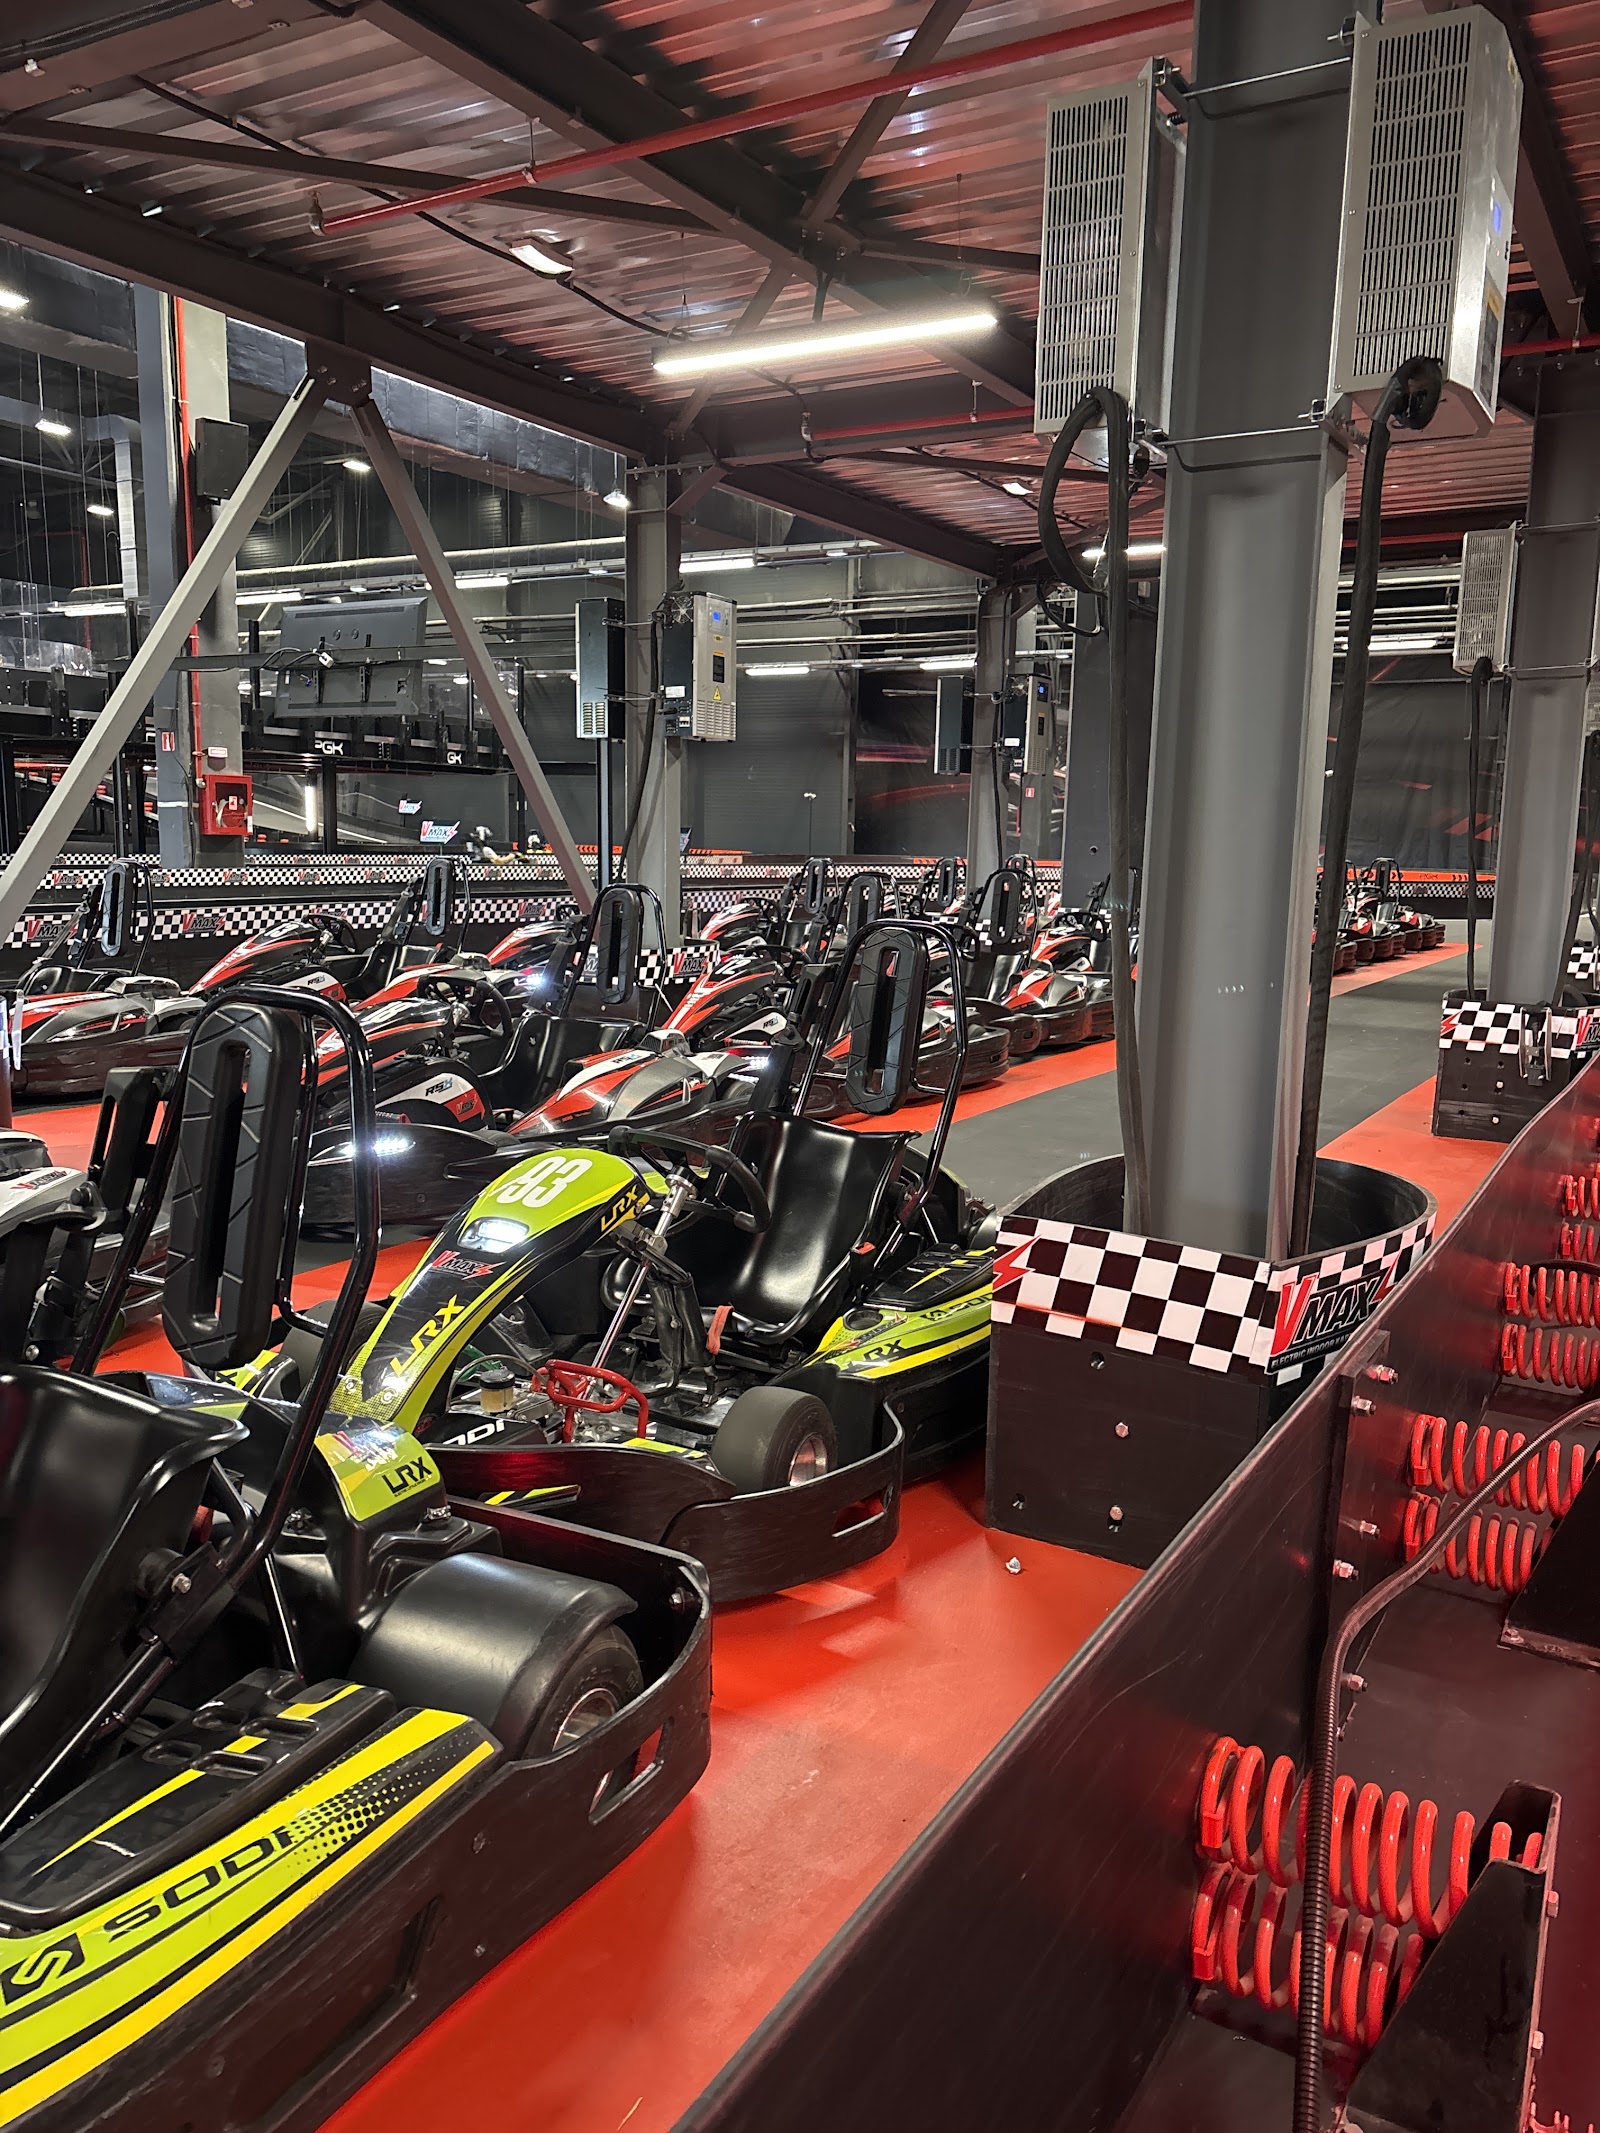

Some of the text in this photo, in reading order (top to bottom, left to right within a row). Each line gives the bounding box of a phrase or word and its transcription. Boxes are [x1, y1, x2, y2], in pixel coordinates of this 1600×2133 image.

[447, 752, 463, 764] GK
[183, 913, 217, 931] VMAX
[674, 953, 703, 974] VMAX
[496, 1156, 593, 1208] 93
[601, 1185, 638, 1231] LRX
[390, 1294, 465, 1376] LRX
[1270, 1272, 1381, 1357] VMAX
[381, 1457, 432, 1494] LRX
